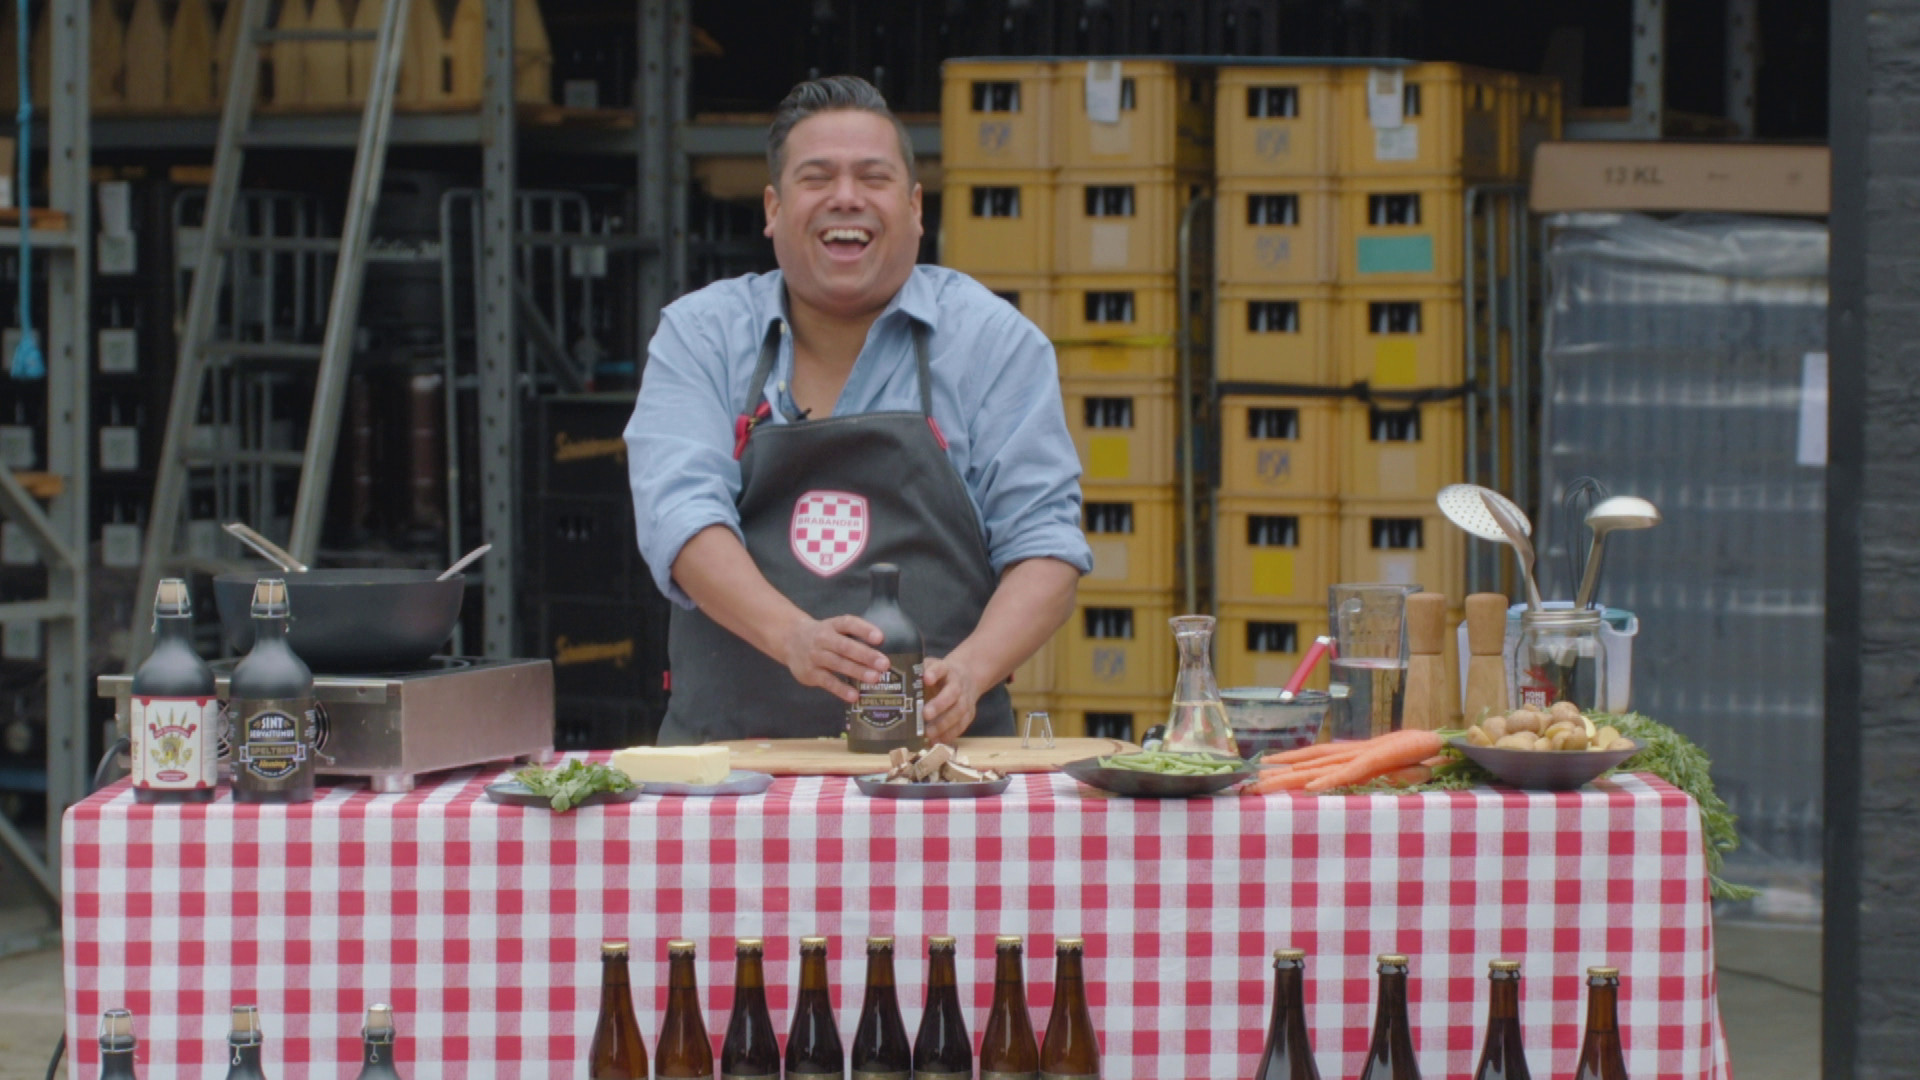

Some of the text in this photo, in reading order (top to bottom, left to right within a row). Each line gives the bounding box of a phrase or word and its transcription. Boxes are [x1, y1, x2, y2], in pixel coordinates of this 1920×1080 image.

[797, 517, 860, 527] BRABANDER
[261, 717, 283, 729] SINT
[250, 747, 297, 755] SPELTBIER
